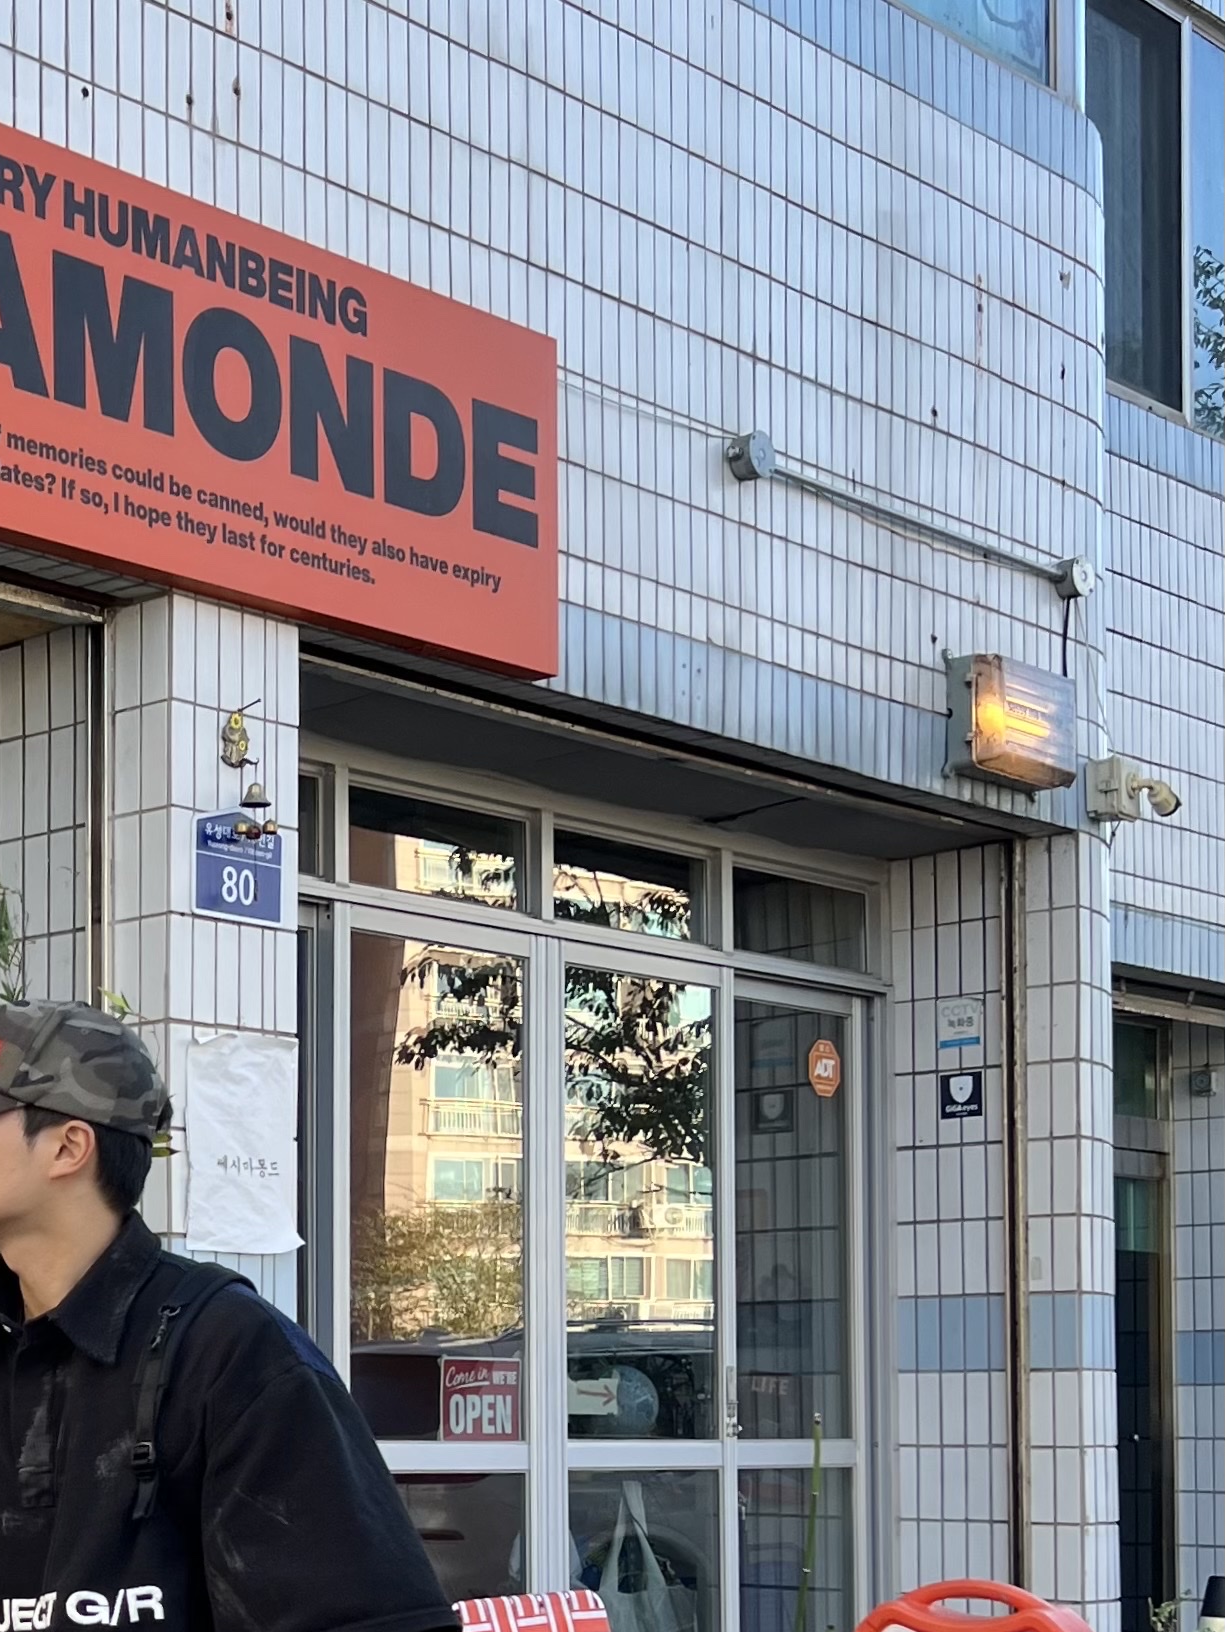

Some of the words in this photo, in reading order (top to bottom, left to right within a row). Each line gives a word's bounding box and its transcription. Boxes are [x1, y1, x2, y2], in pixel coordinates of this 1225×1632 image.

[64, 180, 369, 337] HUMANBEING
[6, 430, 107, 476] memories
[111, 463, 165, 493] could
[169, 474, 193, 500] be
[197, 489, 269, 527] canned,
[273, 510, 326, 540] would
[330, 524, 368, 556] they
[372, 539, 406, 563] also
[409, 546, 449, 575] have
[452, 562, 502, 593] expiry
[61, 476, 76, 500] If
[79, 487, 109, 515] so,
[113, 492, 120, 513] I
[124, 495, 172, 529] hope
[176, 510, 217, 544] they
[222, 523, 255, 552] last
[260, 534, 286, 559] for
[289, 547, 377, 585] centuries.
[221, 865, 255, 906] 80
[941, 1003, 978, 1018] CCTV
[814, 1058, 836, 1079] ADT
[445, 1366, 476, 1388] Come
[449, 1393, 512, 1435] OPEN
[65, 1585, 165, 1626] G/R
